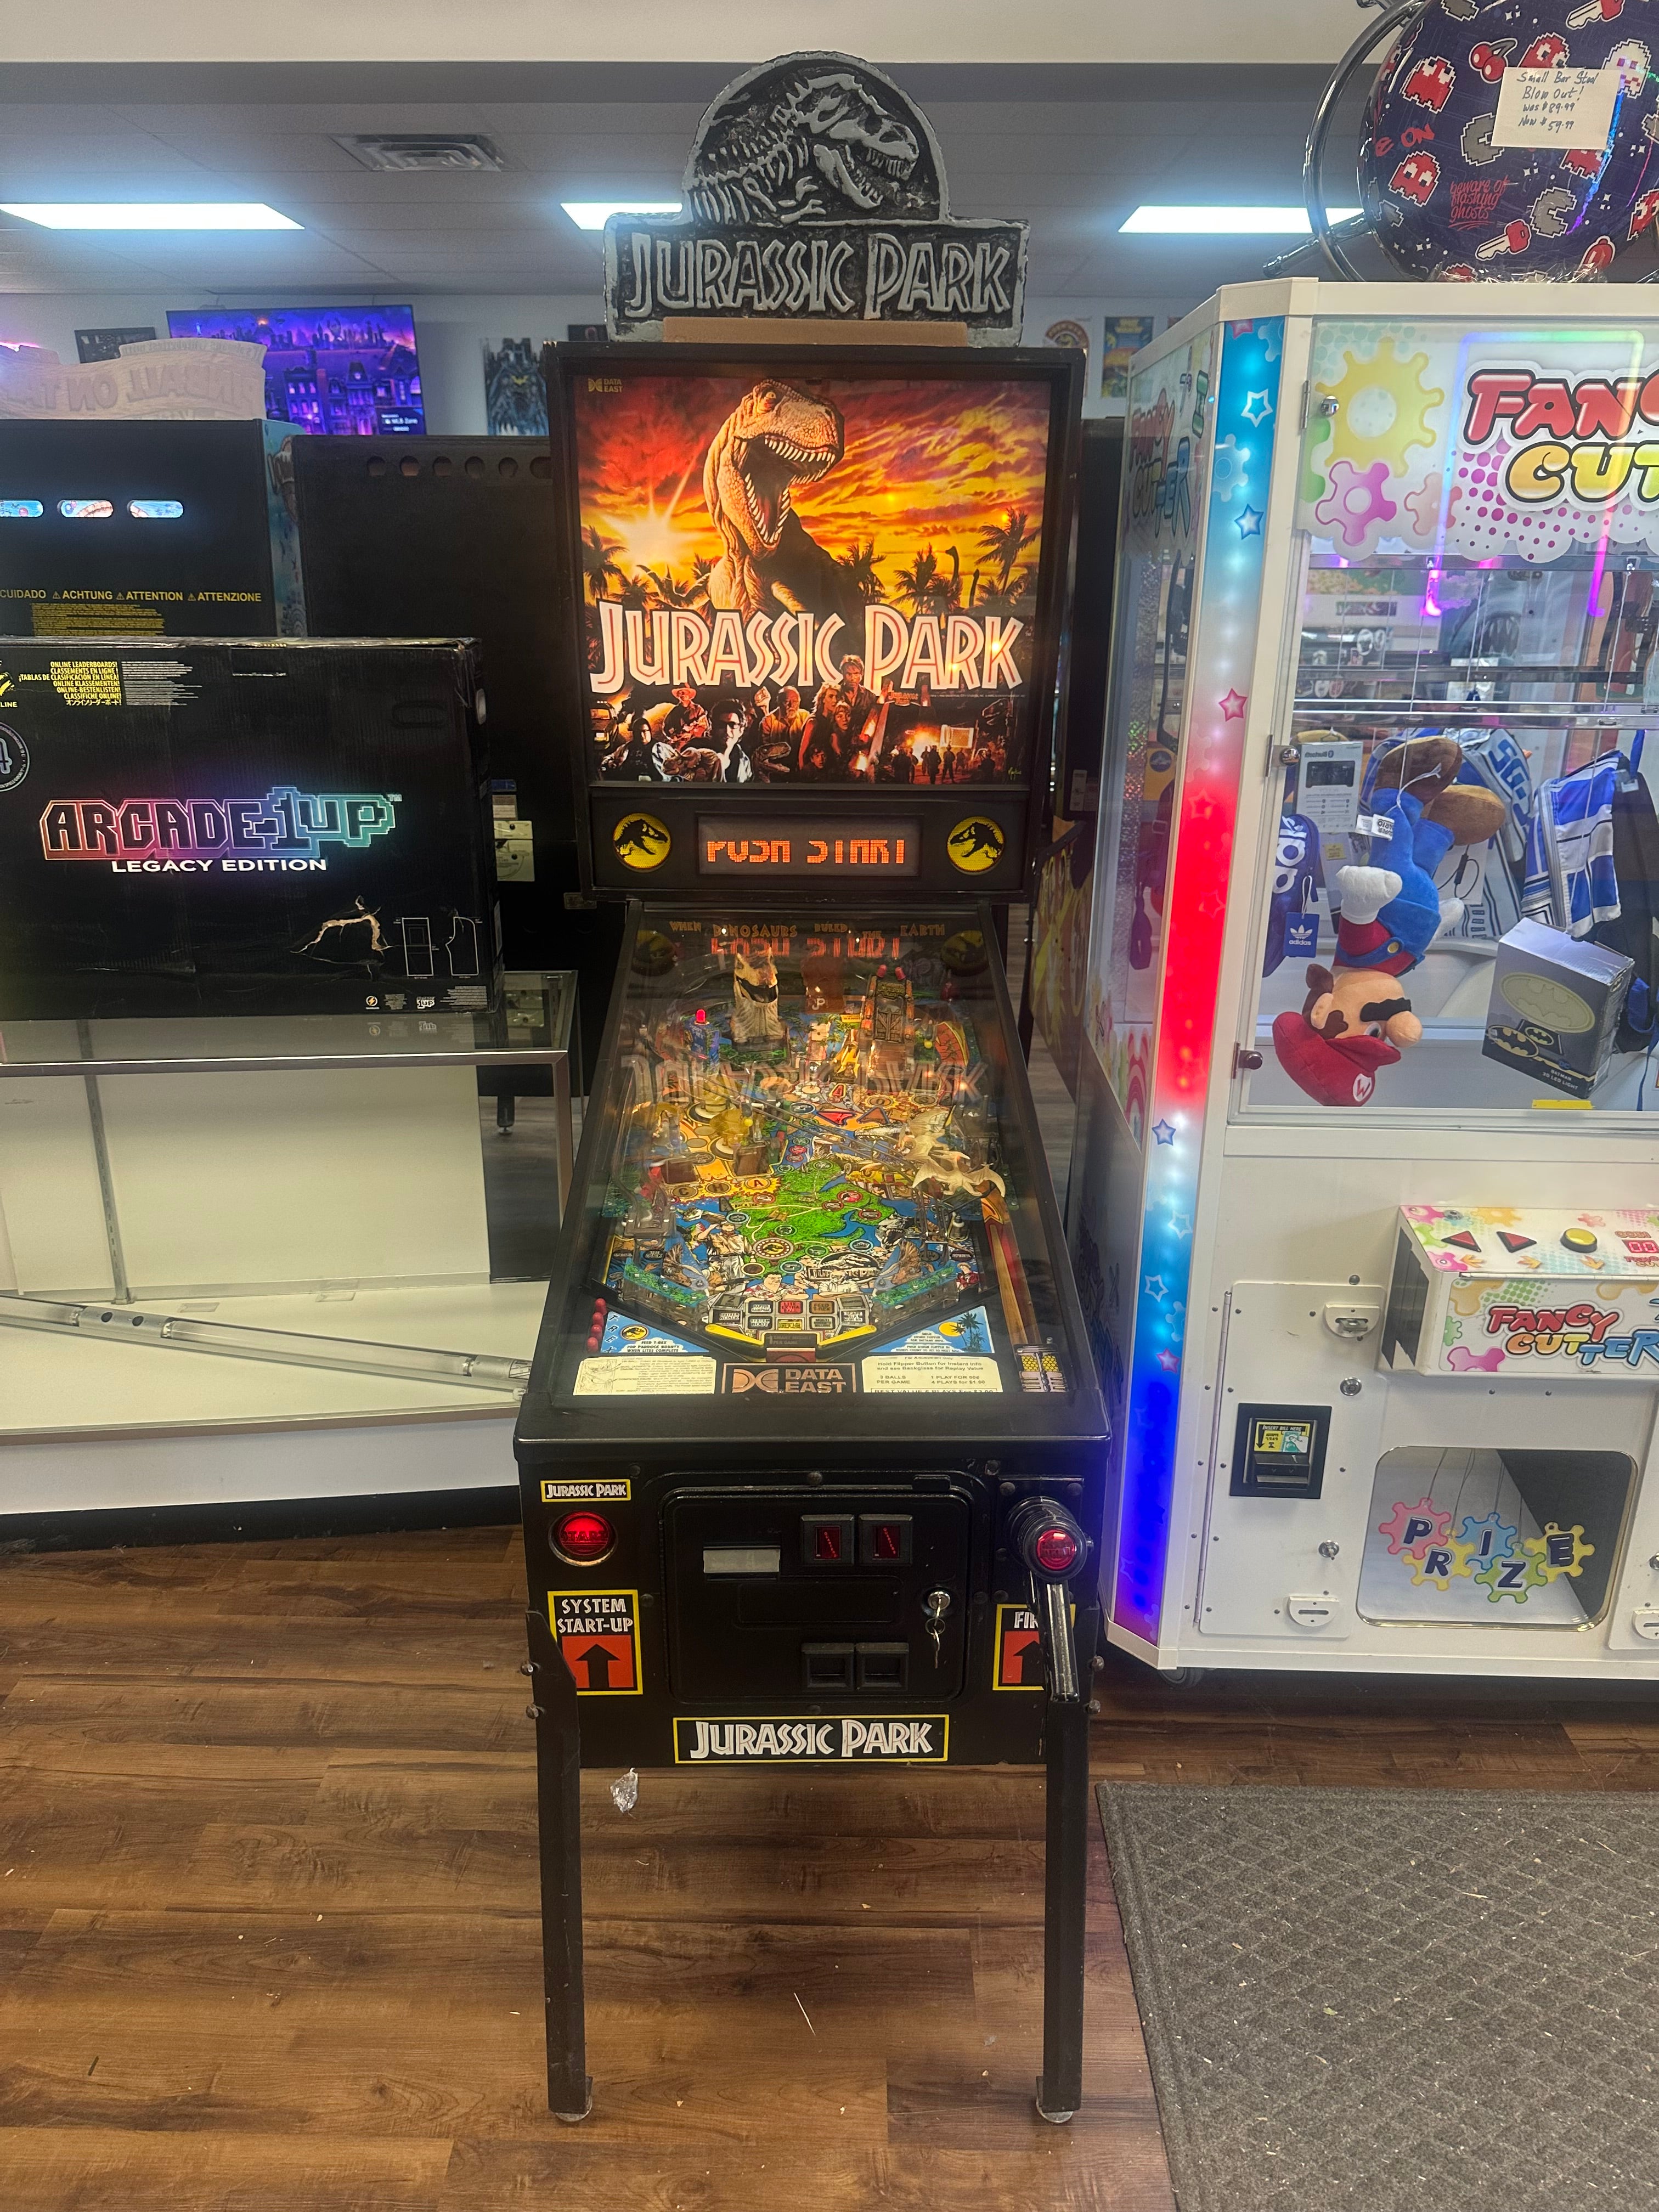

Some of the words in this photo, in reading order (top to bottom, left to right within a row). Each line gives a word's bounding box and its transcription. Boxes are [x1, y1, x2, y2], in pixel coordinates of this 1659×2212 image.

[1516, 71, 1549, 82] Small
[1554, 71, 1571, 83] Bar
[1522, 86, 1549, 100] Blow
[1553, 86, 1584, 100] Out!
[1449, 206, 1491, 223] ghosts
[624, 232, 855, 318] JURASSIC
[864, 232, 1011, 320] PARK
[0, 589, 47, 599] CUIDADO
[63, 590, 113, 600] ACHTUNG
[126, 591, 183, 601] ATTENTION
[197, 592, 262, 602] ATTENZIONE
[590, 600, 845, 693] JURASSIC
[865, 605, 1024, 697] PARK
[1377, 820, 1393, 830] ARIO
[112, 859, 213, 873] LEGACY
[222, 858, 328, 872] EDITION
[669, 921, 702, 932] WHEN
[713, 923, 798, 938] DINOSAURS
[899, 923, 946, 936] EARTH
[1550, 1069, 1572, 1081] BATMAN
[1562, 1079, 1579, 1090] LIGHT
[1487, 1304, 1620, 1342] FANCY
[785, 1369, 844, 1380] DATA
[785, 1381, 847, 1393] EAST
[546, 1483, 594, 1498] JURASSIC
[596, 1483, 627, 1497] PARK
[561, 1598, 627, 1615] SYSTEM
[557, 1617, 634, 1634] START-UP
[690, 1720, 835, 1759] JURASSIC
[841, 1719, 933, 1758] PARK
